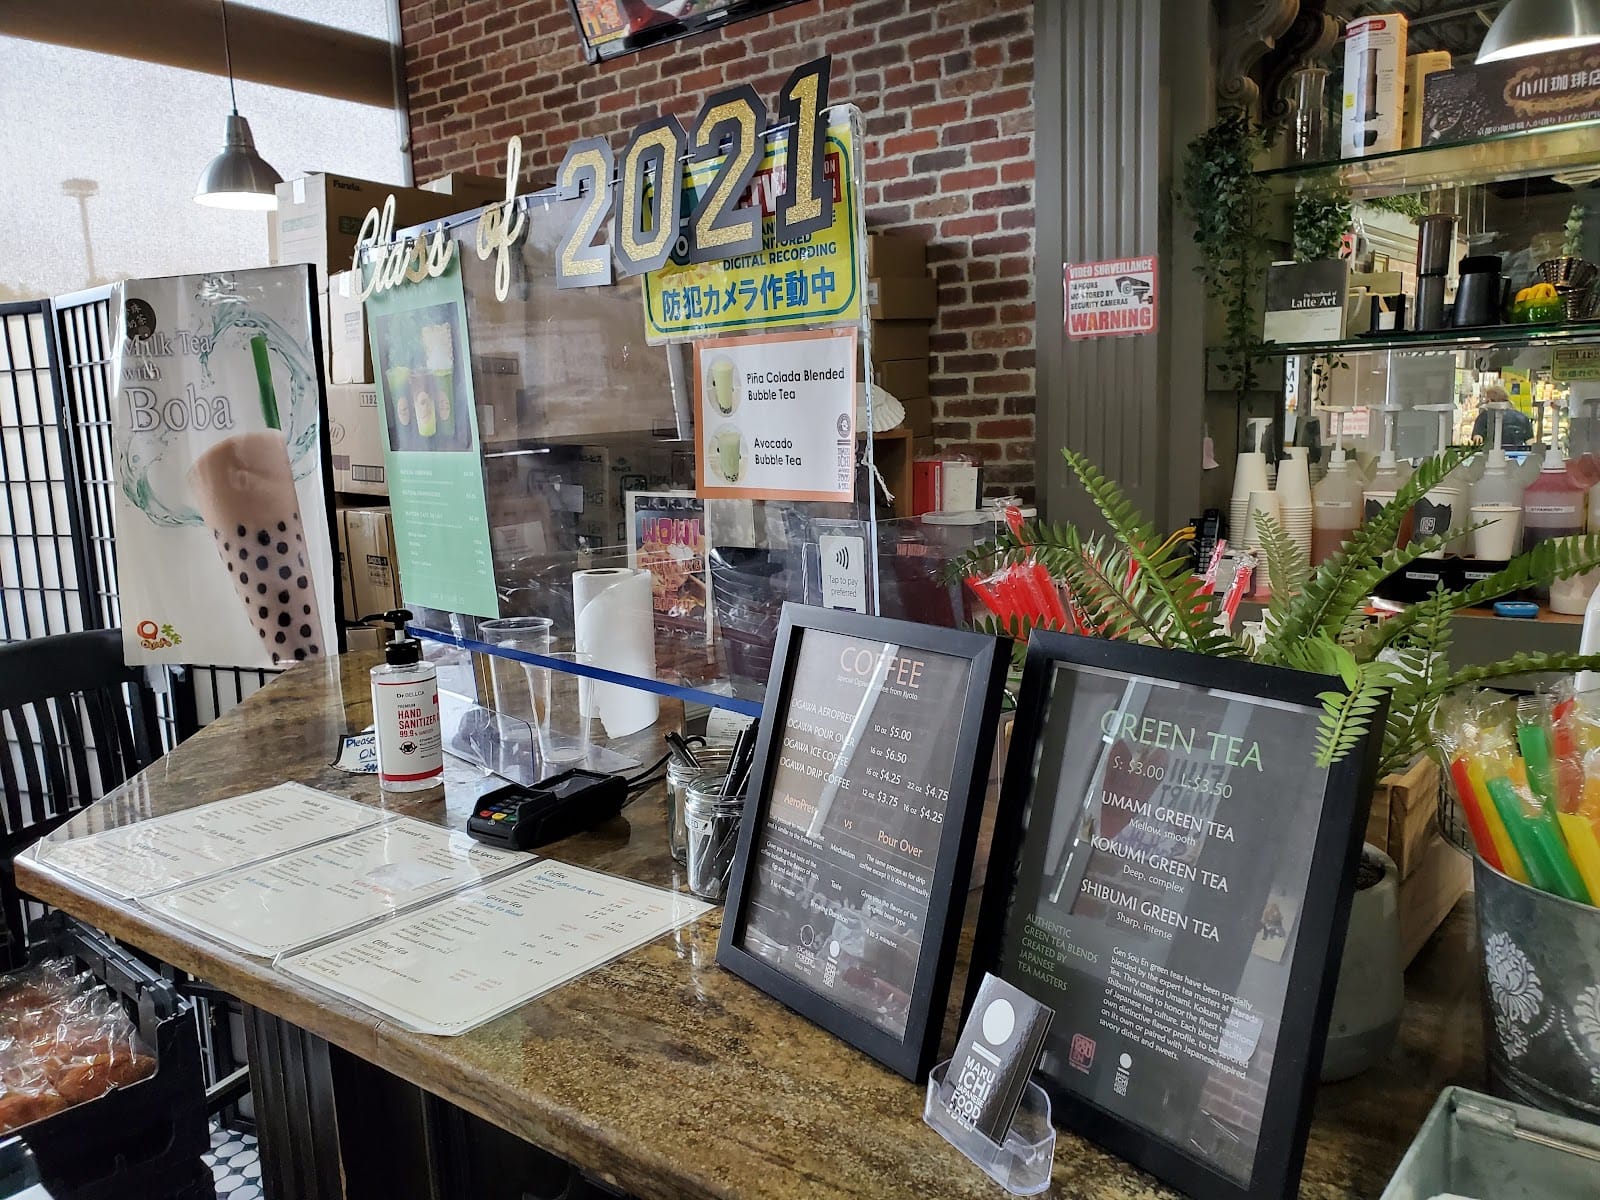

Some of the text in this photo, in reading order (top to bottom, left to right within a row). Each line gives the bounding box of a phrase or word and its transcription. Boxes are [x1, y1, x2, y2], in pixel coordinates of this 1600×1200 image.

[353, 56, 832, 302] Class of 2021
[762, 232, 812, 250] NITORED
[723, 241, 836, 271] DIGITAL RECORDING
[1070, 259, 1152, 278] VIDEO SURVEILLANCE
[662, 266, 835, 322] 防犯カメラ作動中
[1071, 291, 1105, 300] MOTORED
[1071, 298, 1128, 310] SECURITY CAMERAS
[1291, 296, 1336, 308] Latte Art
[1071, 307, 1151, 332] WARNING
[124, 331, 213, 358] Milk Tea
[123, 361, 161, 381] with
[747, 367, 844, 384] Piña Colada Blended
[748, 389, 795, 401] Bubble Tea
[125, 383, 234, 432] Boba
[754, 438, 792, 449] Avocado
[755, 454, 801, 466] Bubble Tea
[828, 575, 839, 585] Tap
[848, 578, 858, 587] pay
[831, 588, 856, 597] preferred
[890, 686, 918, 700] from Kyoto
[398, 708, 421, 720] HAND
[792, 698, 817, 714] OGAWA
[399, 715, 436, 730] SANITIZER
[787, 718, 813, 735] OGAWA
[814, 725, 834, 741] POUR
[890, 725, 912, 741] $5.00
[346, 736, 375, 749] Please
[783, 738, 809, 753] OGAWA
[810, 746, 822, 757] ICE
[1101, 710, 1264, 772] GREEN TEA
[885, 748, 907, 764] $6.50
[780, 757, 851, 789] OGAWA DRIP COFFEE
[880, 768, 901, 785] $4.25
[1113, 755, 1122, 770] S:
[1128, 758, 1164, 781] $3.00
[877, 790, 899, 807] $3.75
[907, 781, 915, 790] 22
[925, 783, 949, 801] $4.75
[903, 804, 910, 812] 16
[920, 805, 944, 824] $4.25
[1102, 791, 1234, 842] UMAMI GREEN TEA
[878, 830, 923, 857] Pour Over
[1129, 818, 1196, 846] Mellow, smooth
[830, 843, 856, 859] Mechanism
[1091, 834, 1228, 892] KOKUMI GREEN TEA
[1149, 876, 1184, 894] complex
[486, 894, 509, 905] Green
[509, 900, 523, 909] Tea
[1081, 879, 1219, 942] SHIBUMI GREEN TEA
[1026, 913, 1072, 938] AUTHENTIC
[1143, 922, 1173, 940] intense
[1022, 937, 1067, 963] CREATED BY
[1024, 925, 1099, 963] GREEN TEA BLENDS
[1019, 949, 1055, 972] JAPANESE
[1017, 960, 1068, 991] TEA MASTERS
[1110, 966, 1121, 978] Tea.
[1124, 972, 1139, 986] They
[1140, 981, 1164, 996] created
[1111, 956, 1229, 1012] blended by the expert tea masters at
[1113, 947, 1253, 1011] Gen Sou En green teas have been specially
[1105, 988, 1113, 996] of
[1113, 991, 1141, 1009] Japanese
[1142, 1003, 1152, 1014] tea
[1180, 1020, 1196, 1033] Each
[1198, 1028, 1218, 1043] blend
[1107, 977, 1217, 1031] Shibumi blends to honor the finest
[965, 1055, 996, 1084] MARU
[959, 1066, 991, 1102] ICHI
[950, 1089, 981, 1119] FOOD
[956, 1085, 985, 1109] JAPANESE
